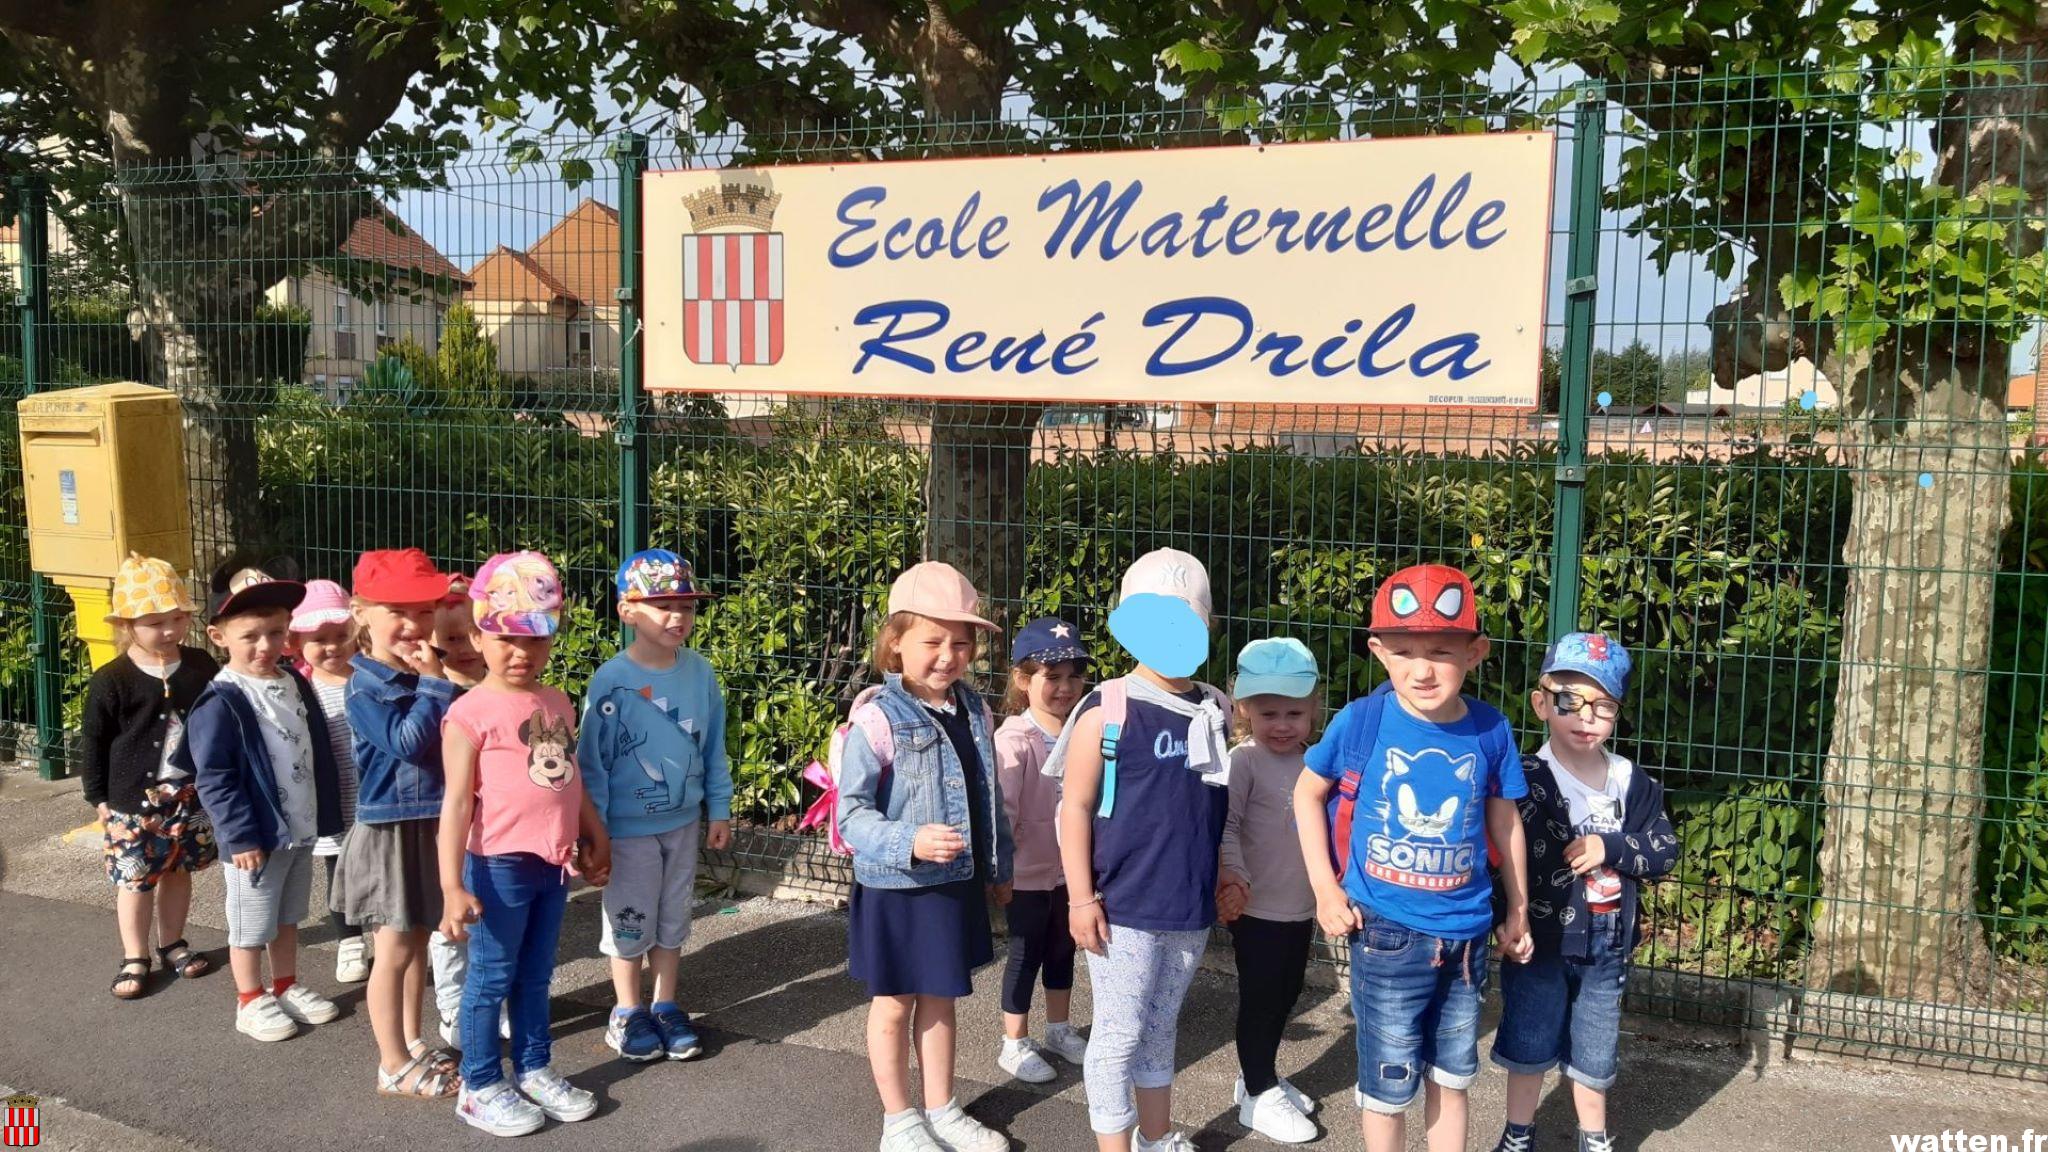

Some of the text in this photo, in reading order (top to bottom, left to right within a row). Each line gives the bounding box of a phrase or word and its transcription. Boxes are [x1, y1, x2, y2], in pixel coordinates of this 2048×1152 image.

[829, 174, 1508, 268] Ecole Maternelle
[853, 297, 1490, 381] René Drila
[1368, 836, 1474, 874] SONIC
